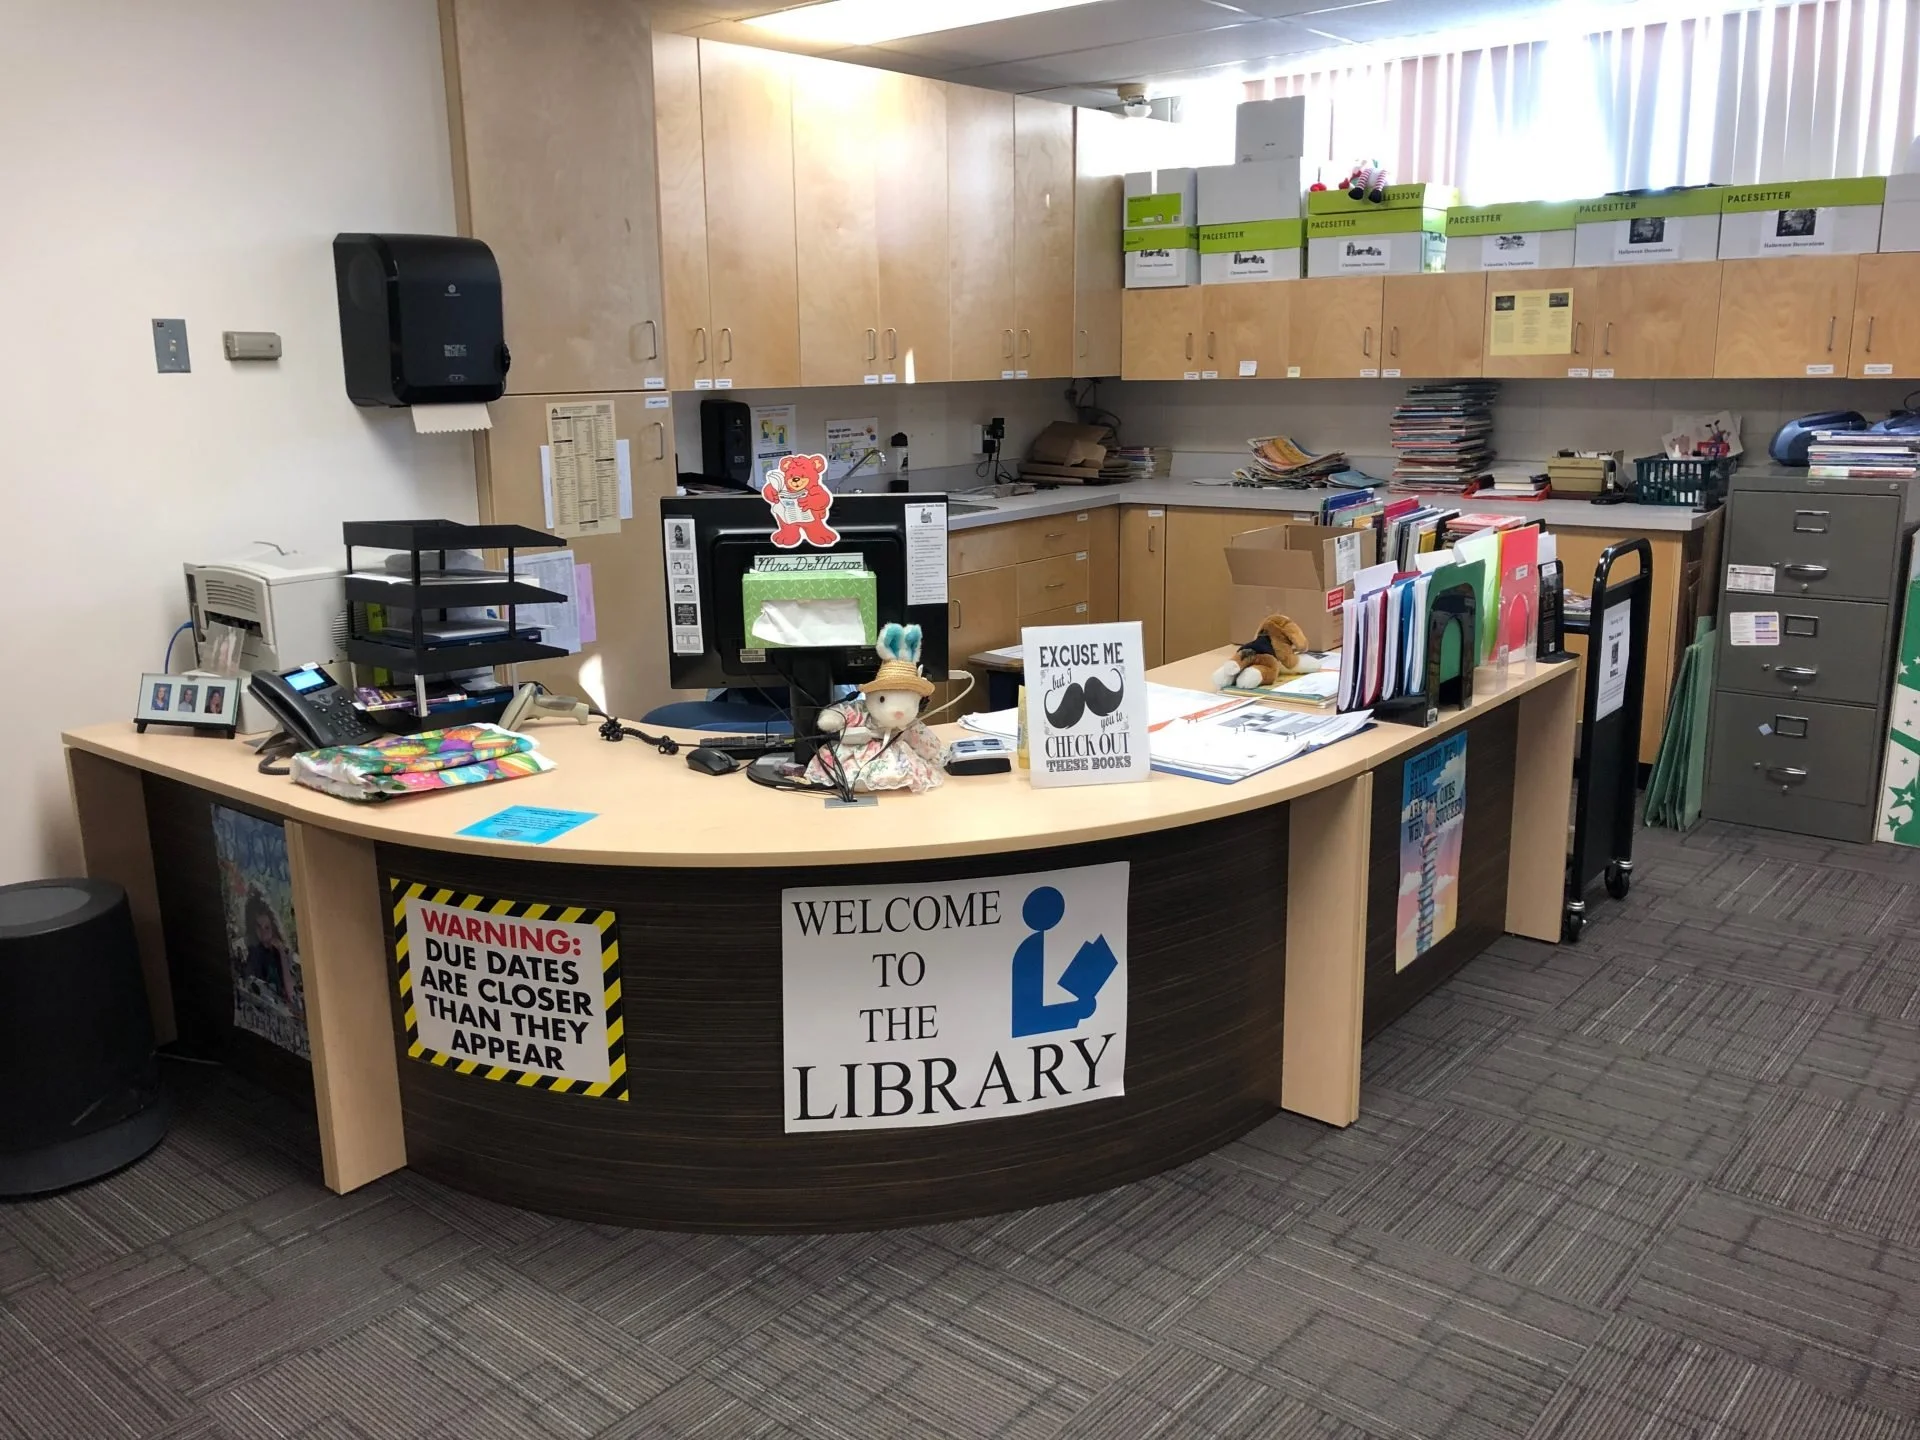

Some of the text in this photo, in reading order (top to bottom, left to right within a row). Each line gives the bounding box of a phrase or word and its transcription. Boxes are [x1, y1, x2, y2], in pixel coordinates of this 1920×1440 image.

[1579, 201, 1638, 213] PACESETTER
[1727, 191, 1792, 204] PACESETTER
[1311, 219, 1356, 229] PACESETTER
[1449, 214, 1502, 225] PACESETTER
[1202, 231, 1244, 241] PACESETTER
[1039, 642, 1124, 668] EXCUSE ME
[1052, 674, 1065, 690] but
[1100, 711, 1123, 732] you to
[1045, 732, 1130, 759] CHECK OUT
[1046, 755, 1132, 772] THESE BOOKS
[1409, 800, 1423, 822] ARE
[792, 890, 1002, 936] WELCOME
[421, 908, 581, 956] WARNING:
[425, 938, 579, 985] DUE DATES
[872, 951, 926, 988] TO
[420, 965, 594, 1017] ARE CLOSER
[425, 993, 589, 1044] THAN THEY
[859, 1005, 939, 1043] THE
[451, 1029, 565, 1071] APPEAR
[792, 1032, 1117, 1121] LIBRARY
